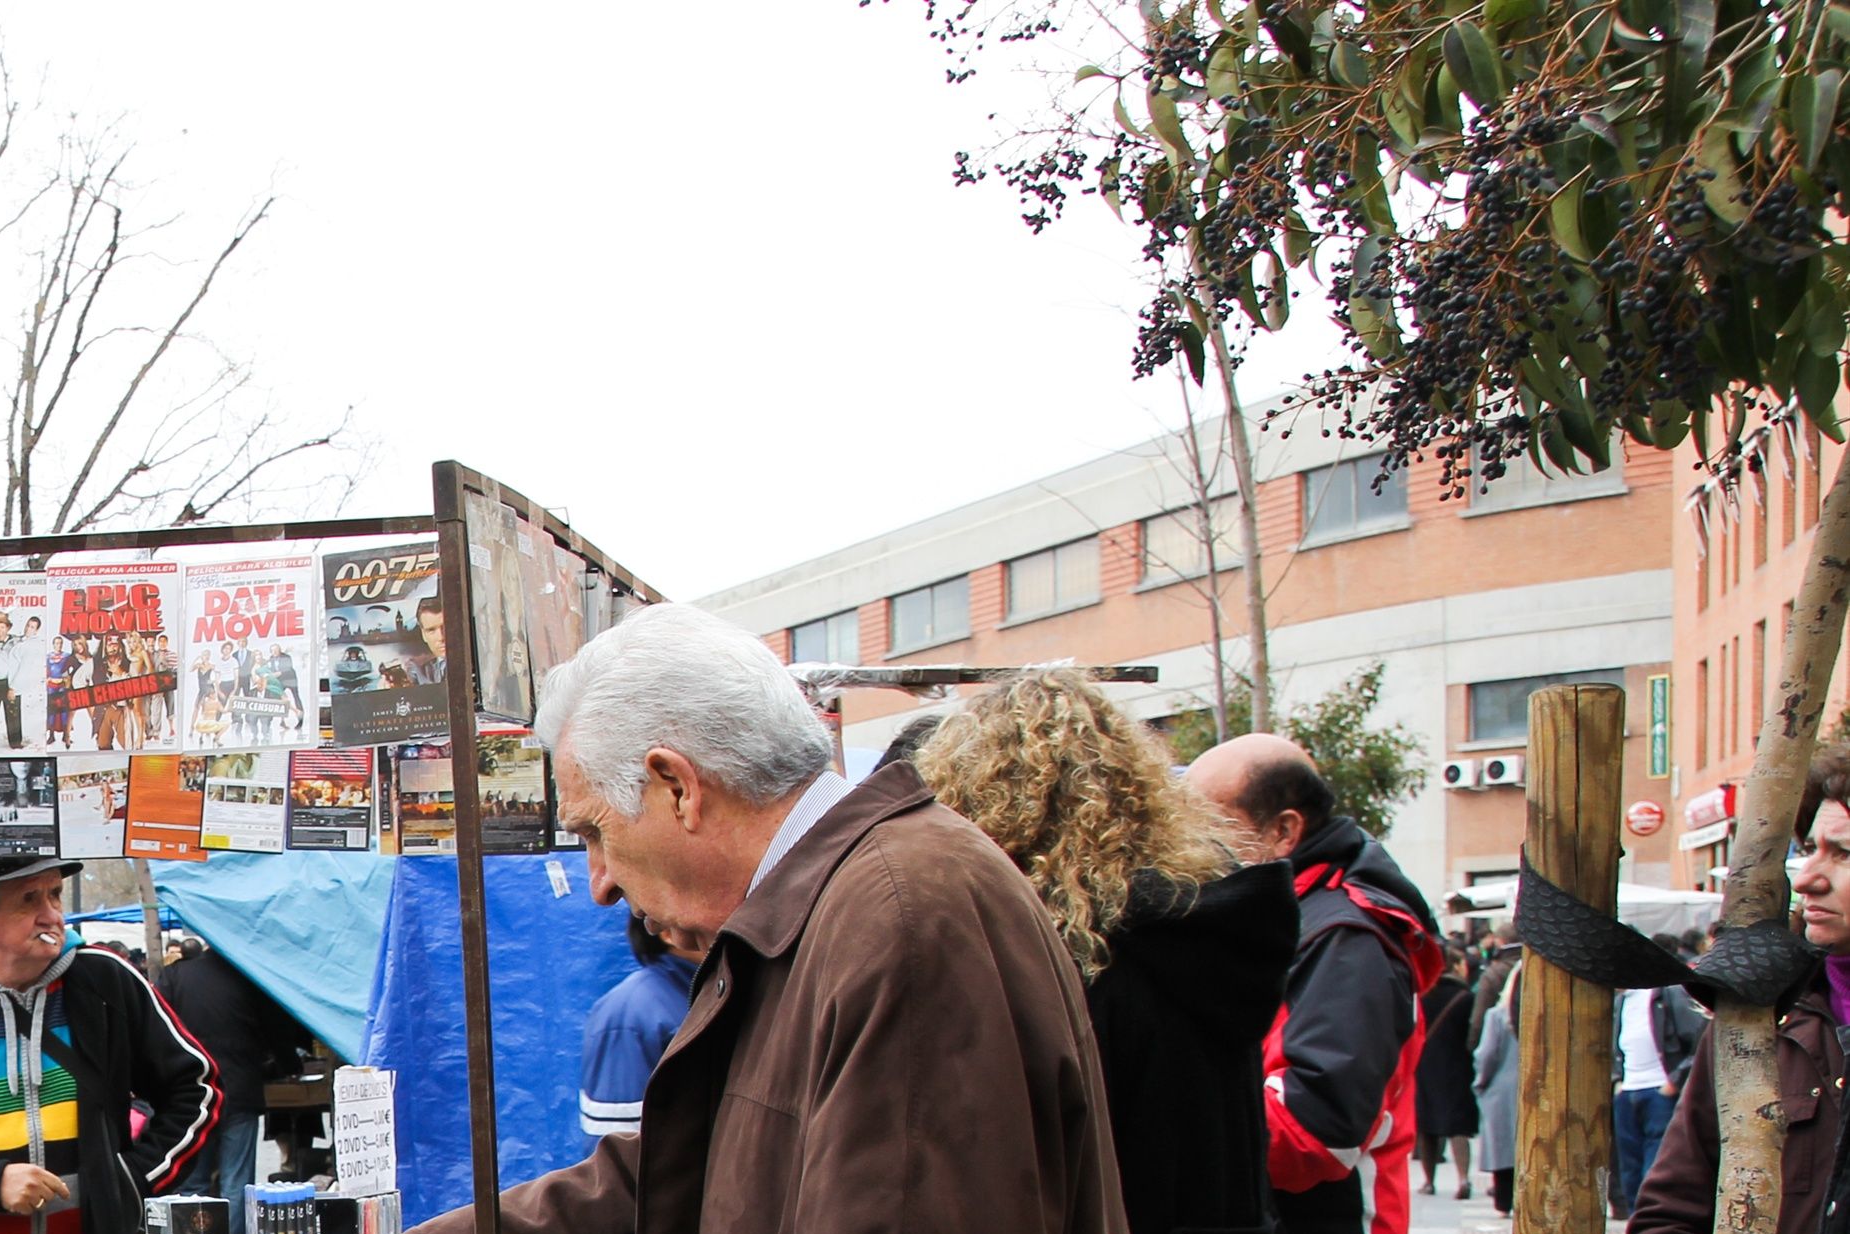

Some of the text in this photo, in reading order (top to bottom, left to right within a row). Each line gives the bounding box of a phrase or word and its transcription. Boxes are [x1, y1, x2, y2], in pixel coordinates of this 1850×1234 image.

[99, 566, 124, 574] PARA
[127, 564, 176, 573] ALQUILER
[333, 553, 439, 602] 007
[62, 583, 161, 613] EPIC
[204, 583, 295, 616] DATE
[60, 610, 165, 636] MOVIE
[193, 610, 304, 643] MOVIE
[68, 689, 90, 710] SIN
[232, 700, 286, 714] SIN CENSURA
[409, 713, 446, 723] EDITIO
